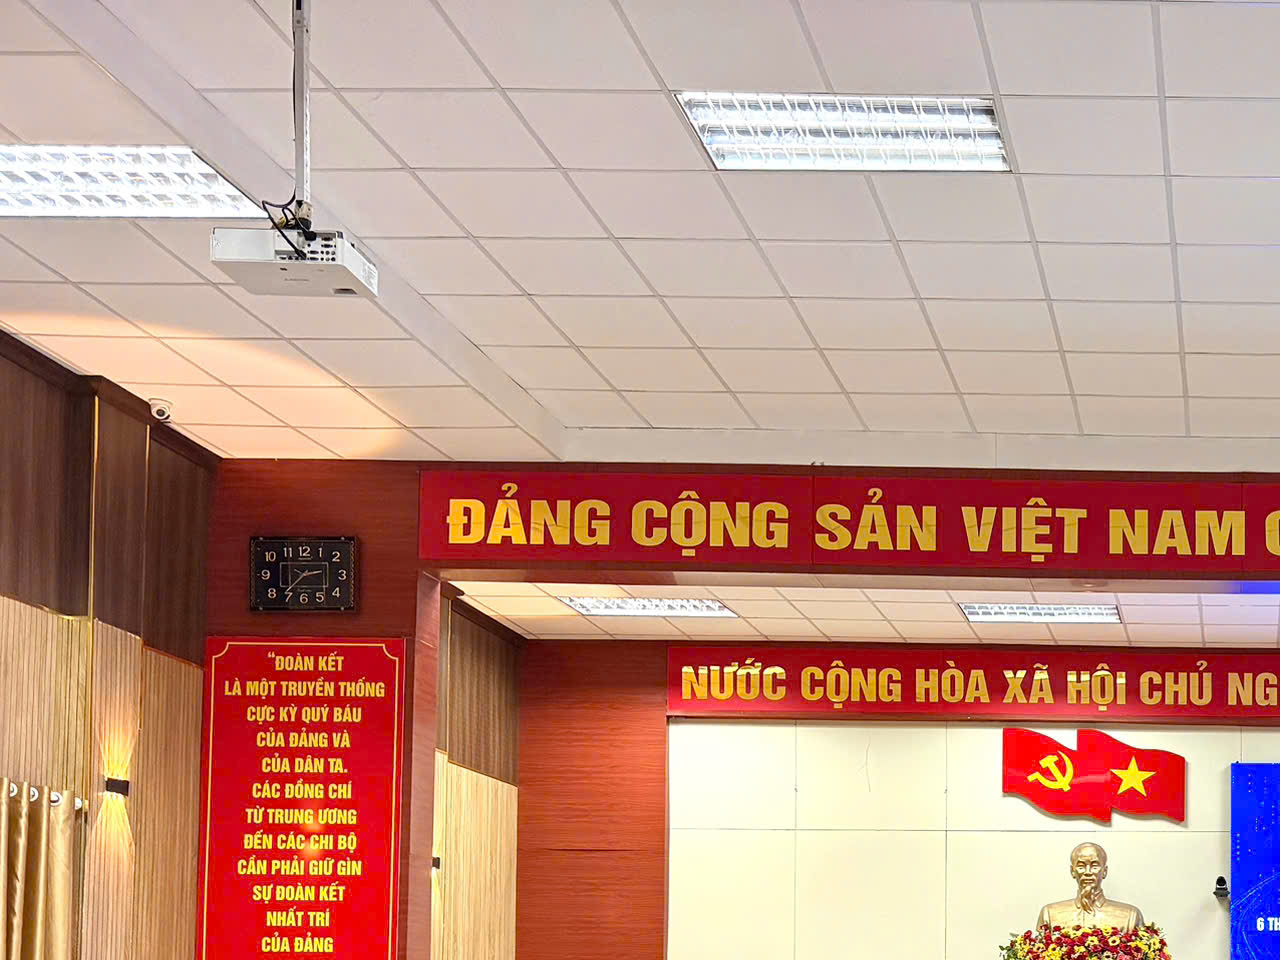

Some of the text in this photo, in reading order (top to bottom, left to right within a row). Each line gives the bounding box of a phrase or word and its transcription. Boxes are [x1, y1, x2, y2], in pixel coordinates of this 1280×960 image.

[447, 483, 610, 545] ĐẢNG
[631, 491, 788, 557] CỘNG
[815, 488, 937, 552] SẢN
[962, 498, 1087, 562] VIỆT
[1109, 508, 1245, 556] NAM
[319, 651, 344, 671] KẾT
[225, 677, 384, 699] LÀ MỘT TRUYỀN THỐNG
[681, 659, 786, 702] NƯỚC
[801, 660, 902, 709] CỘNG
[915, 661, 990, 703] HÒA
[1003, 664, 1052, 704] XÃ
[1067, 662, 1127, 711] HỘI
[1140, 661, 1213, 706] CHỦ
[247, 704, 361, 724] CỰC KỲ QUÝ BÁU
[257, 728, 350, 747] CỦA ĐẢNG VÀ
[262, 753, 347, 773] CỦA DÂN TA.
[253, 779, 351, 799] CÁC ĐỒNG CHÍ
[245, 805, 357, 825] TỪ TRUNG ƯƠNG
[244, 830, 357, 853] ĐẾN CÁC CHI BỘ
[238, 855, 361, 875] CẦN PHẢI GIỮ GÌN
[253, 882, 345, 903] SỰ ĐOÀN KẾT
[267, 906, 330, 927] NHẤT TRÍ
[1256, 917, 1265, 931] 6
[262, 932, 333, 952] CỦA ĐẢNG
